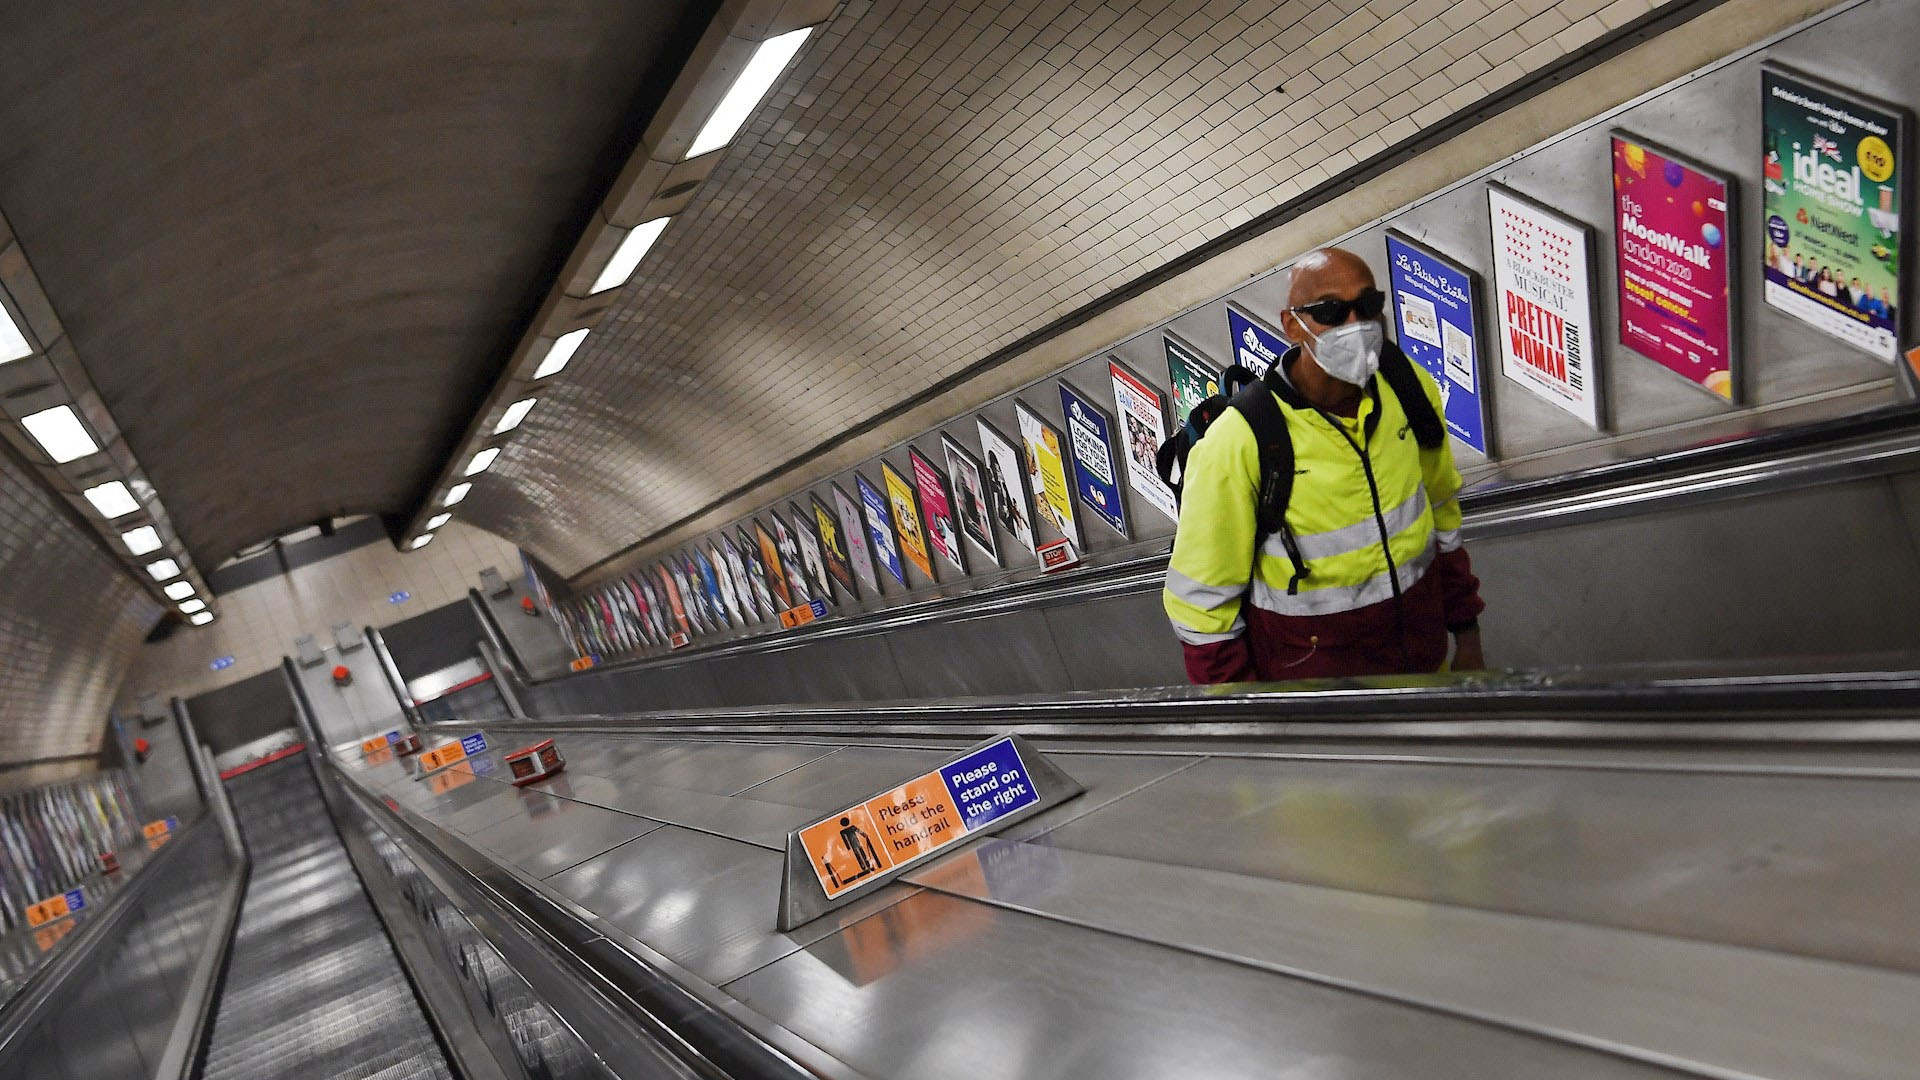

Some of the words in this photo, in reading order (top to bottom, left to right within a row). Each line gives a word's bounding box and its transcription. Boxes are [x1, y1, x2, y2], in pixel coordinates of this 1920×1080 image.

[1792, 141, 1864, 206] ideal
[1622, 194, 1643, 218] the
[1622, 212, 1711, 270] MoonWalk
[1622, 231, 1666, 269] london
[1666, 258, 1692, 281] 2020
[1396, 253, 1412, 272] Les
[1412, 260, 1440, 288] Petites
[1512, 260, 1575, 299] BLOCKBUSTER
[1514, 273, 1568, 312] MUSICAL
[1506, 289, 1564, 351] PRETTY
[1509, 325, 1568, 384] WOMAN
[1564, 321, 1583, 371] MUSICAL
[1569, 371, 1584, 392] THE
[1132, 400, 1158, 430] ROBBERY
[1072, 423, 1106, 457] LOOKING
[1075, 435, 1089, 452] FOR
[1088, 445, 1108, 468] YOUR
[1077, 446, 1093, 465] NEXT
[1044, 548, 1062, 560] STOP
[951, 761, 998, 788] Please
[960, 775, 1000, 803] stand
[1001, 769, 1020, 784] on
[878, 795, 925, 821] Please
[966, 800, 993, 817] the
[993, 783, 1027, 805] right
[886, 812, 918, 836] hold
[920, 803, 945, 819] the
[893, 817, 951, 851] handrail
